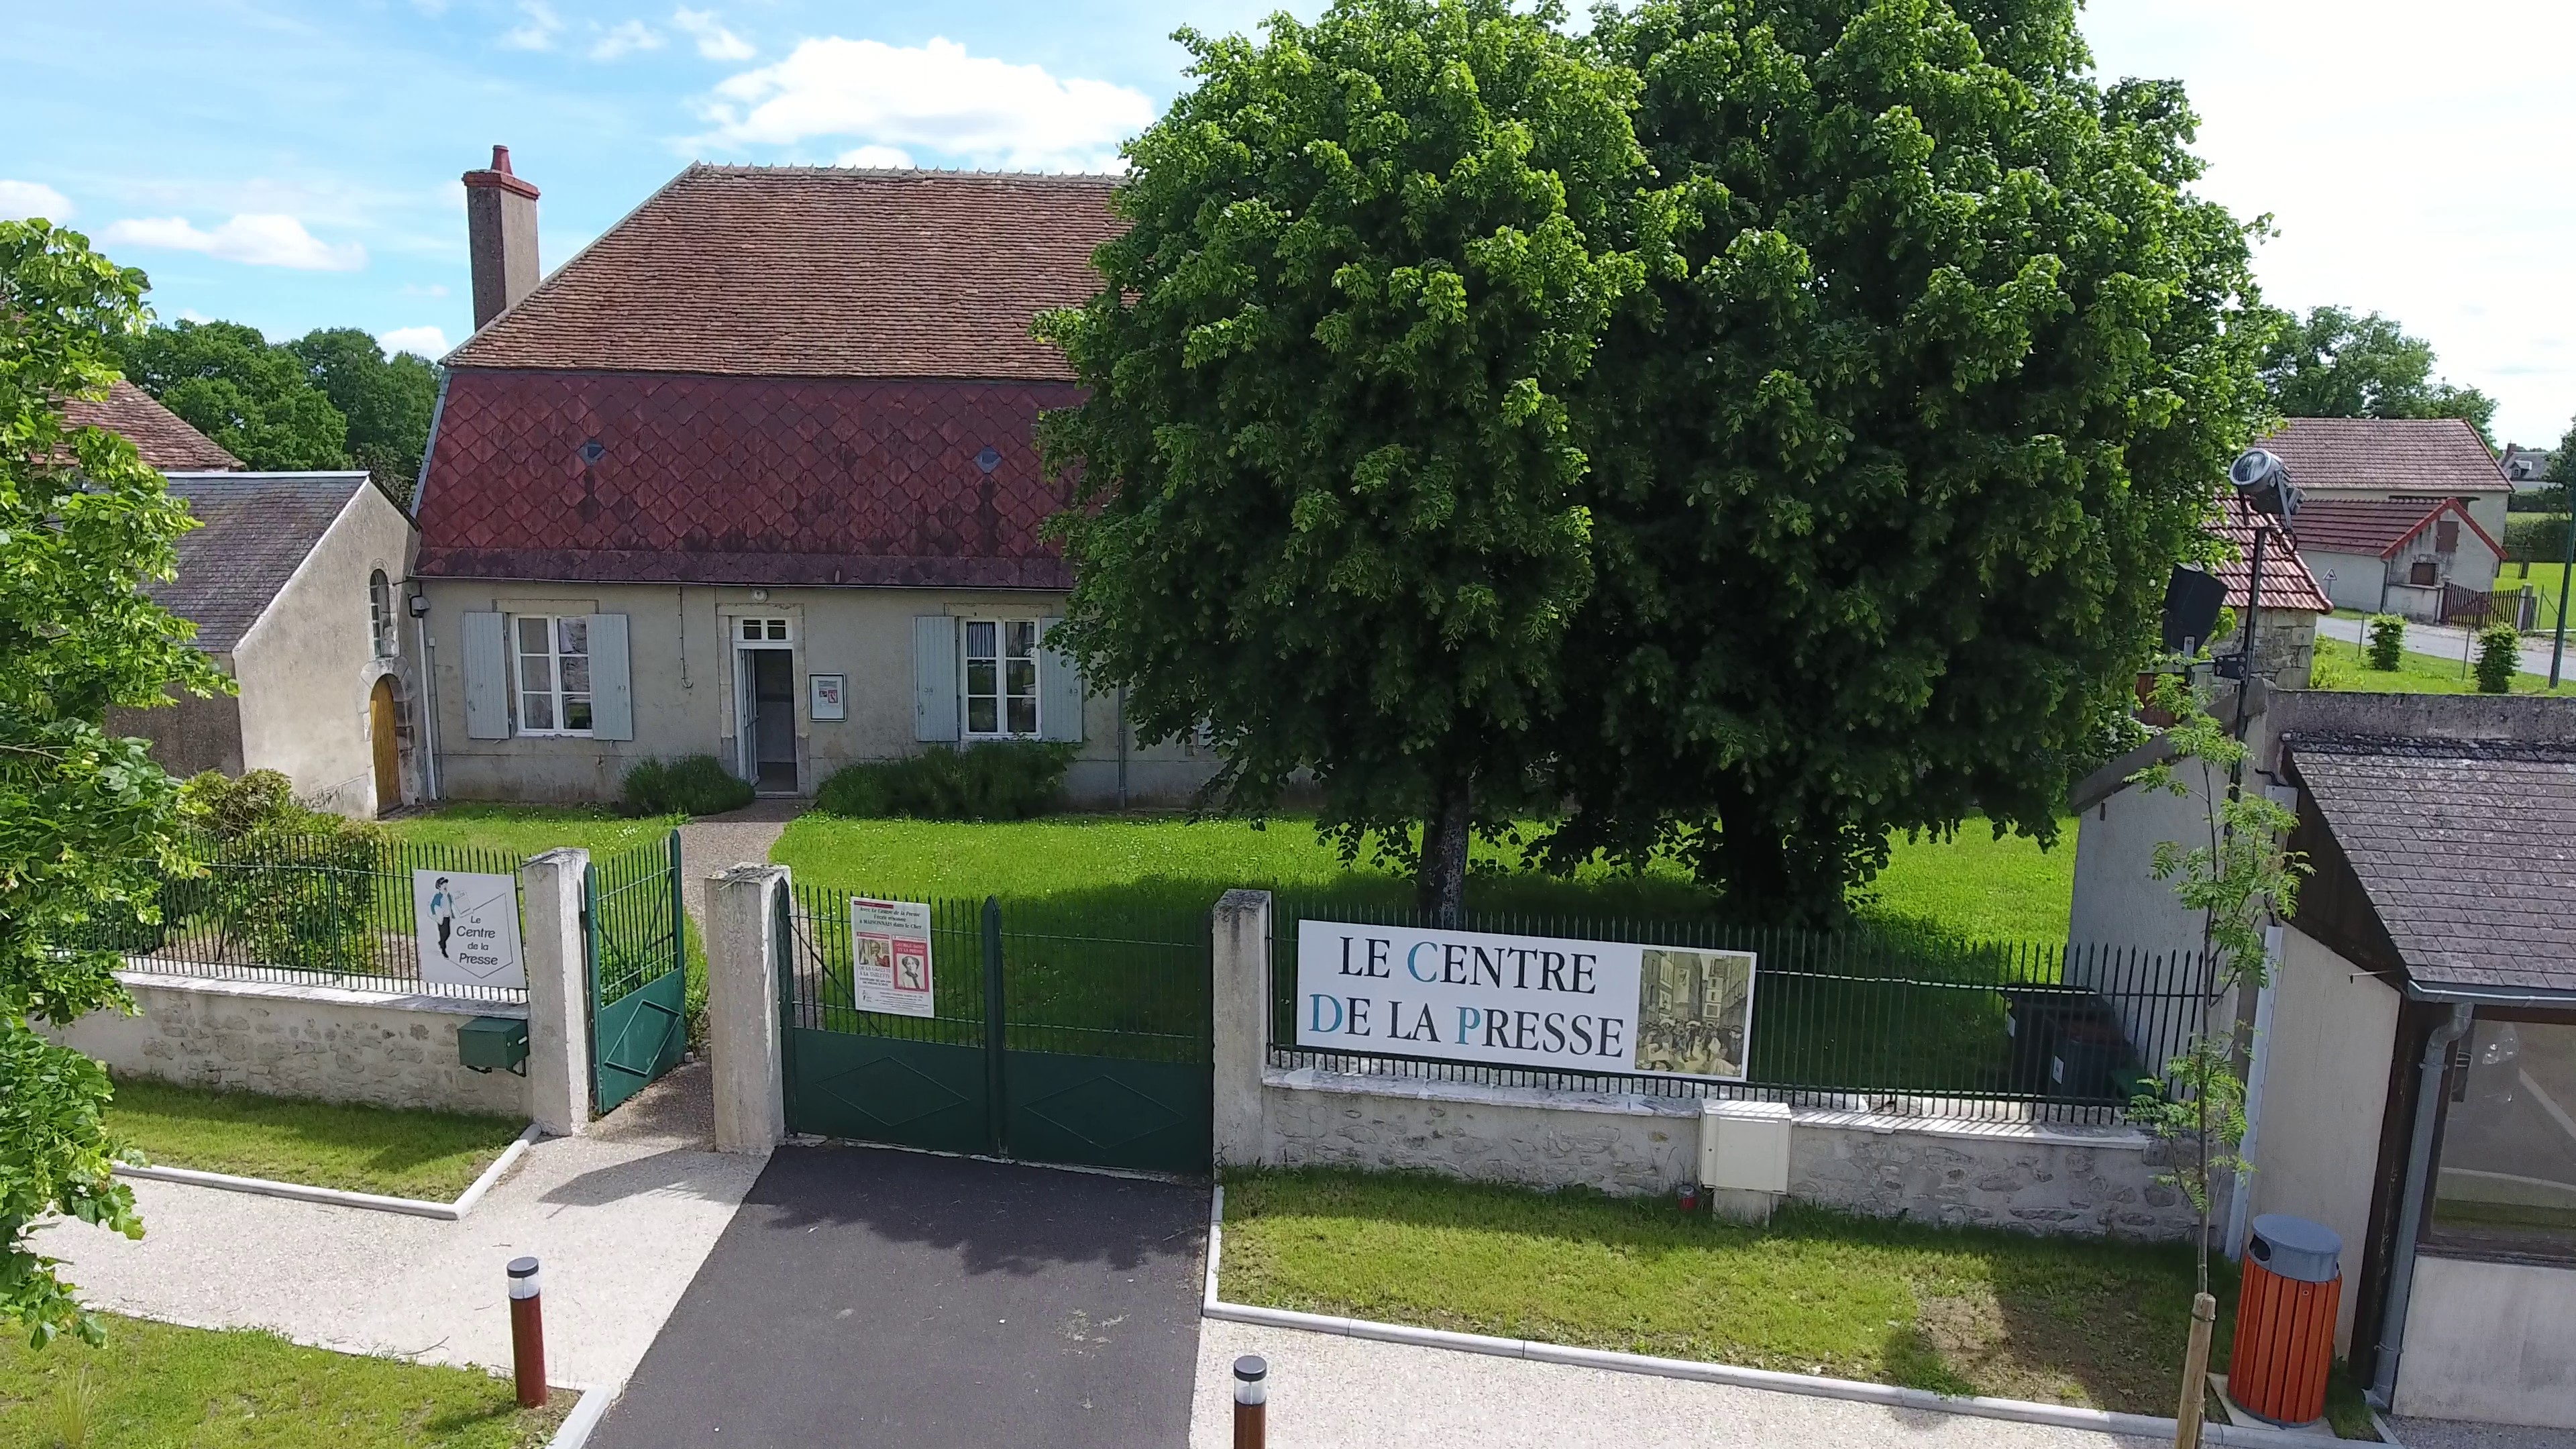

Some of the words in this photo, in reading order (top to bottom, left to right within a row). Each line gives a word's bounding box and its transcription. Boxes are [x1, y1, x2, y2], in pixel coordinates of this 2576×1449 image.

[470, 916, 481, 924] Le
[456, 926, 495, 938] Centre
[481, 943, 489, 951] la
[459, 953, 498, 965] Presse
[1338, 936, 1391, 978] LE
[1407, 941, 1597, 994] CENTRE
[1308, 993, 1371, 1036] DE
[1387, 1000, 1441, 1042] LA
[1454, 1006, 1623, 1057] PRESSE
